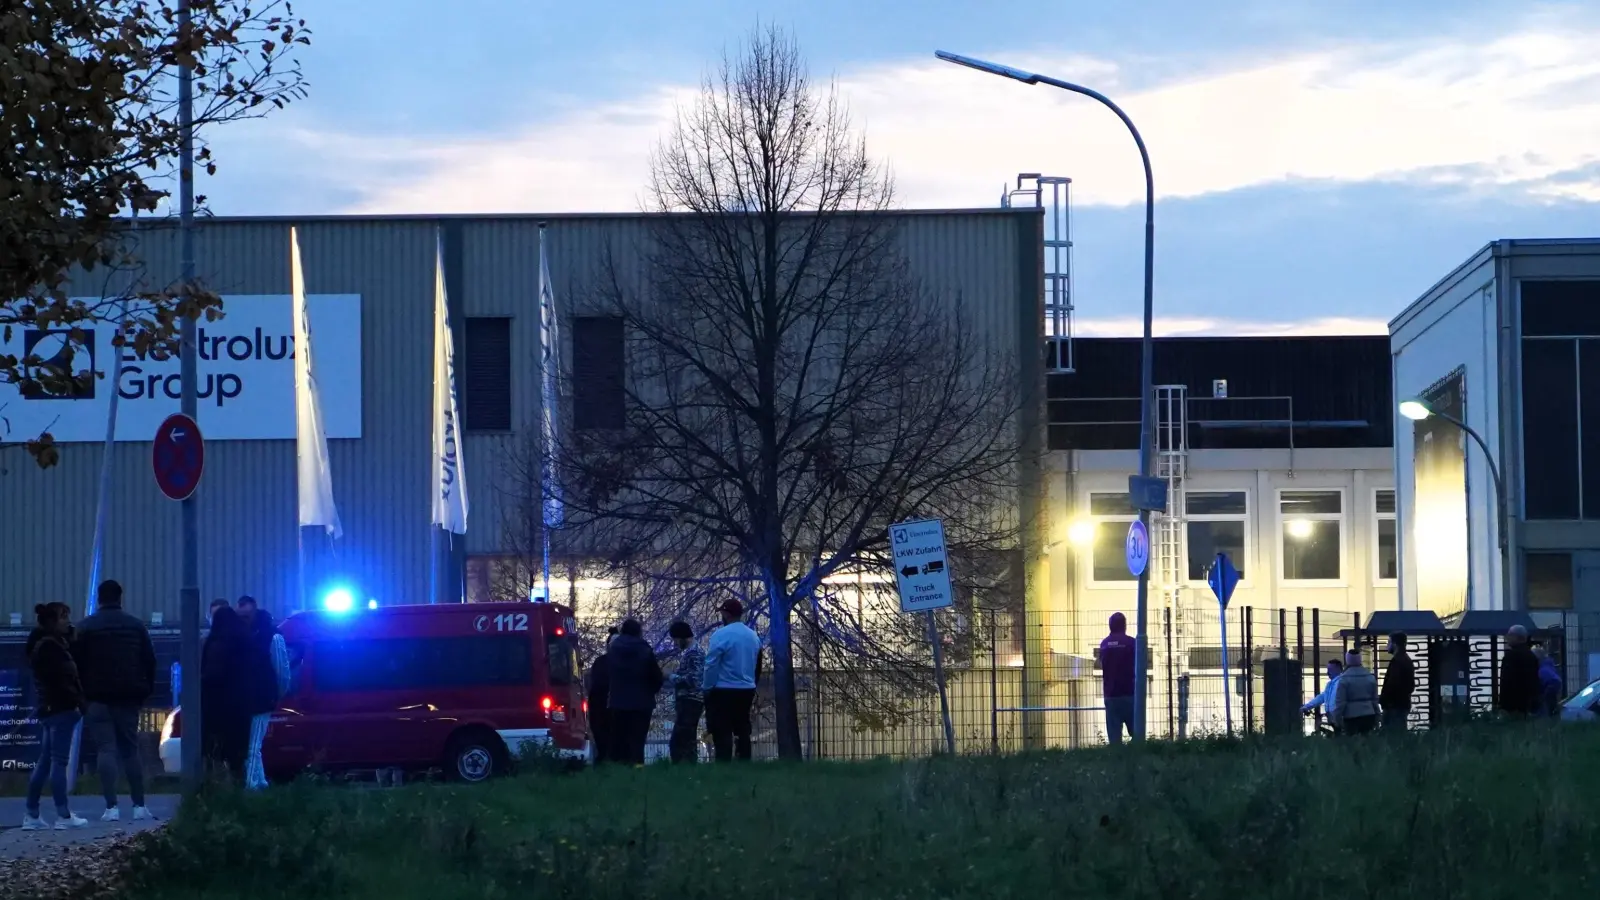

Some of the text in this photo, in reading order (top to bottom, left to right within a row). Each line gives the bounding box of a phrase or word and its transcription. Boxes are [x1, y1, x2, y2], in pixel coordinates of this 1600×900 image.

[114, 326, 296, 362] Etrolu
[117, 365, 243, 407] Group
[1216, 382, 1224, 395] F
[896, 545, 942, 558] LKW Zufahrt
[1130, 536, 1143, 559] 30
[914, 583, 935, 592] Truck
[909, 593, 943, 602] Entrance
[493, 613, 529, 632] 112
